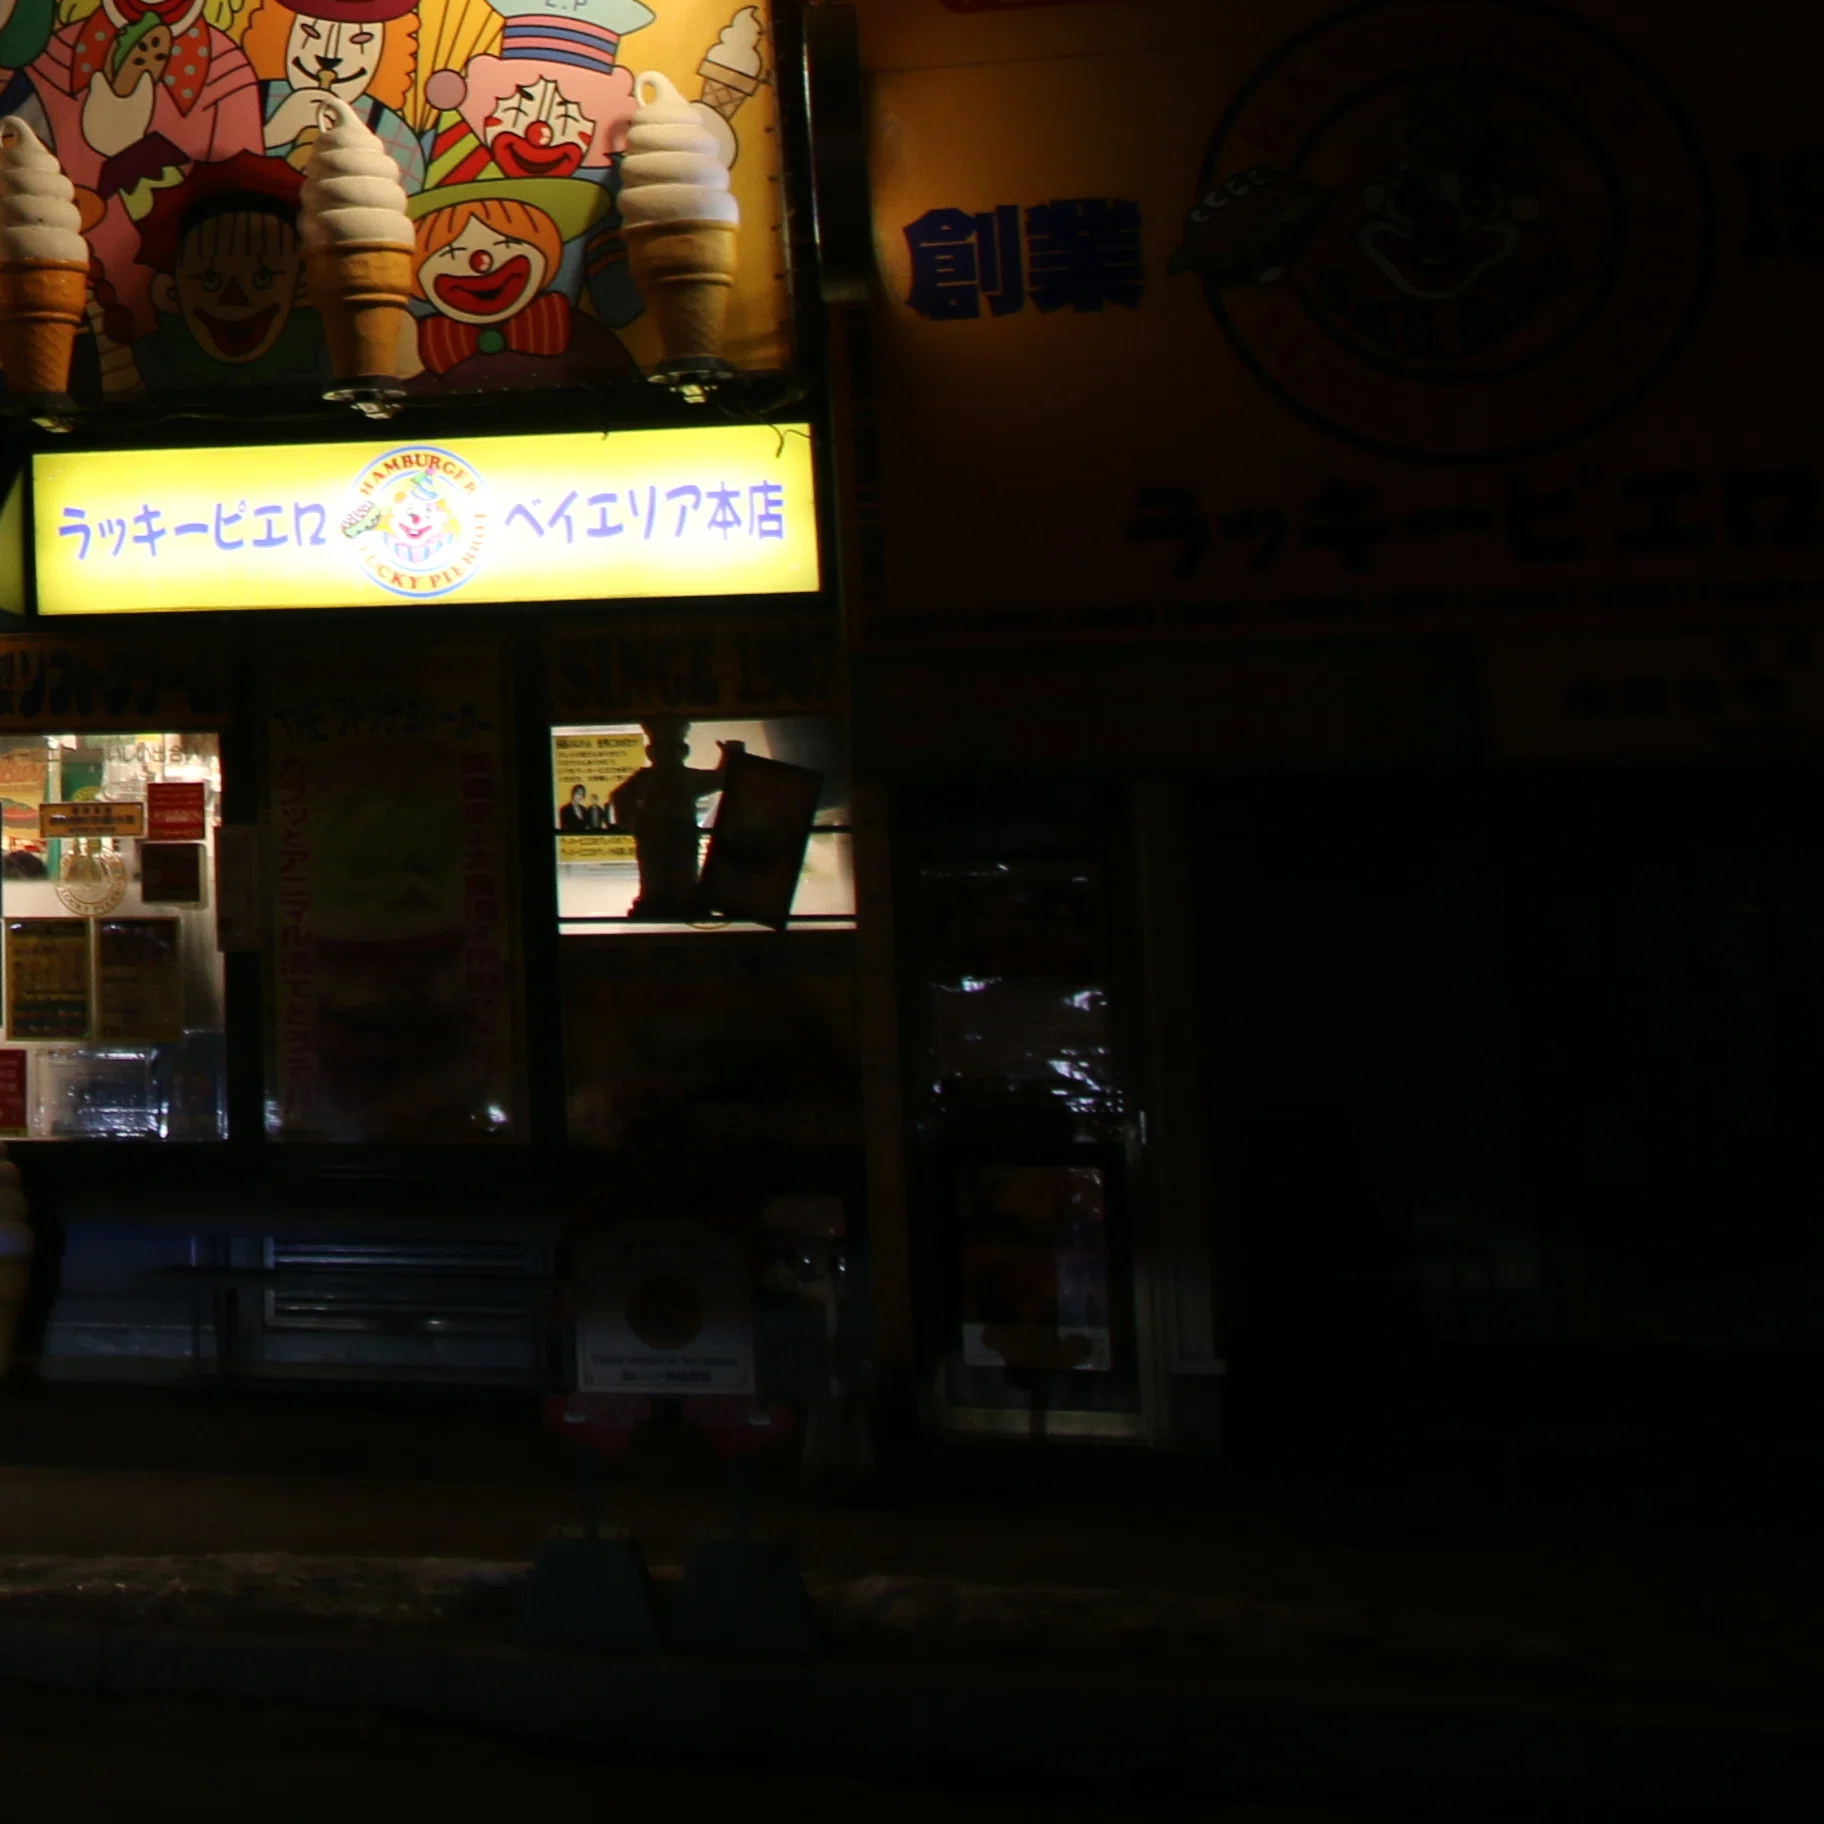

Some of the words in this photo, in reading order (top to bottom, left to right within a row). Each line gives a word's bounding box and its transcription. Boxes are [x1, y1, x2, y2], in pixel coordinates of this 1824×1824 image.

[903, 195, 1145, 321] 創業
[58, 499, 328, 560] ラッキーピエロ
[504, 479, 785, 544] ベイエリア本店
[1123, 458, 1818, 579] ラッキーピエロ
